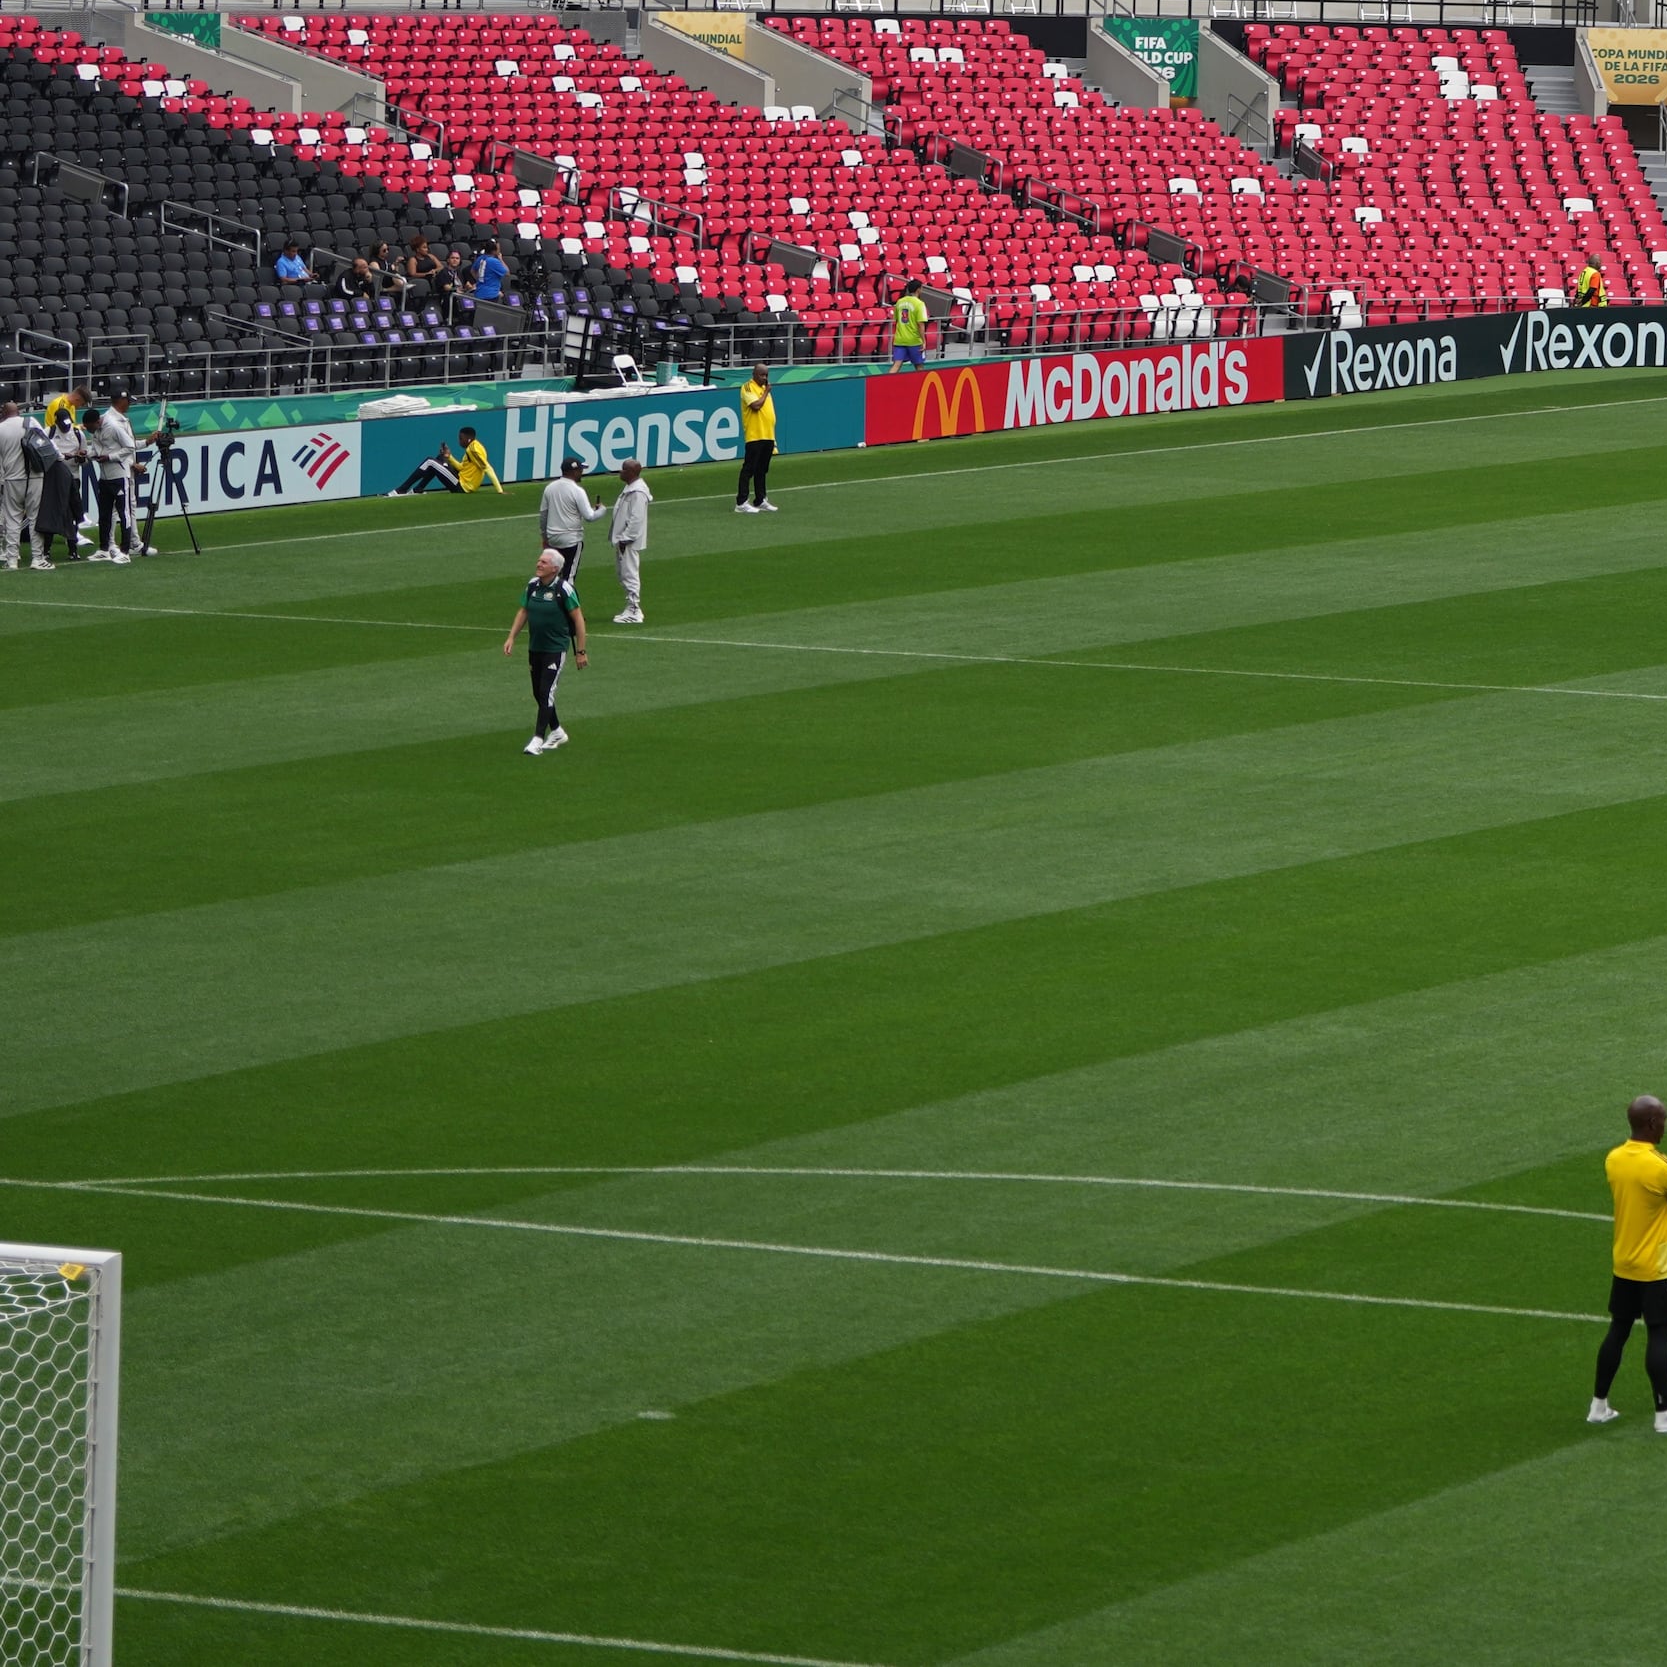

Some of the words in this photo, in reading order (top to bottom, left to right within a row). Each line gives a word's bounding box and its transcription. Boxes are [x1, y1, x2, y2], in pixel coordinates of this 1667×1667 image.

[1134, 36, 1167, 50] FIFA
[1164, 51, 1194, 65] CUP
[1591, 47, 1625, 60] COPA
[1604, 61, 1621, 71] DE
[1623, 61, 1639, 71] LA
[1613, 73, 1659, 85] 2026
[1330, 330, 1457, 394] Rexona
[1003, 340, 1249, 430] McDonald's
[503, 403, 740, 483] Hisense
